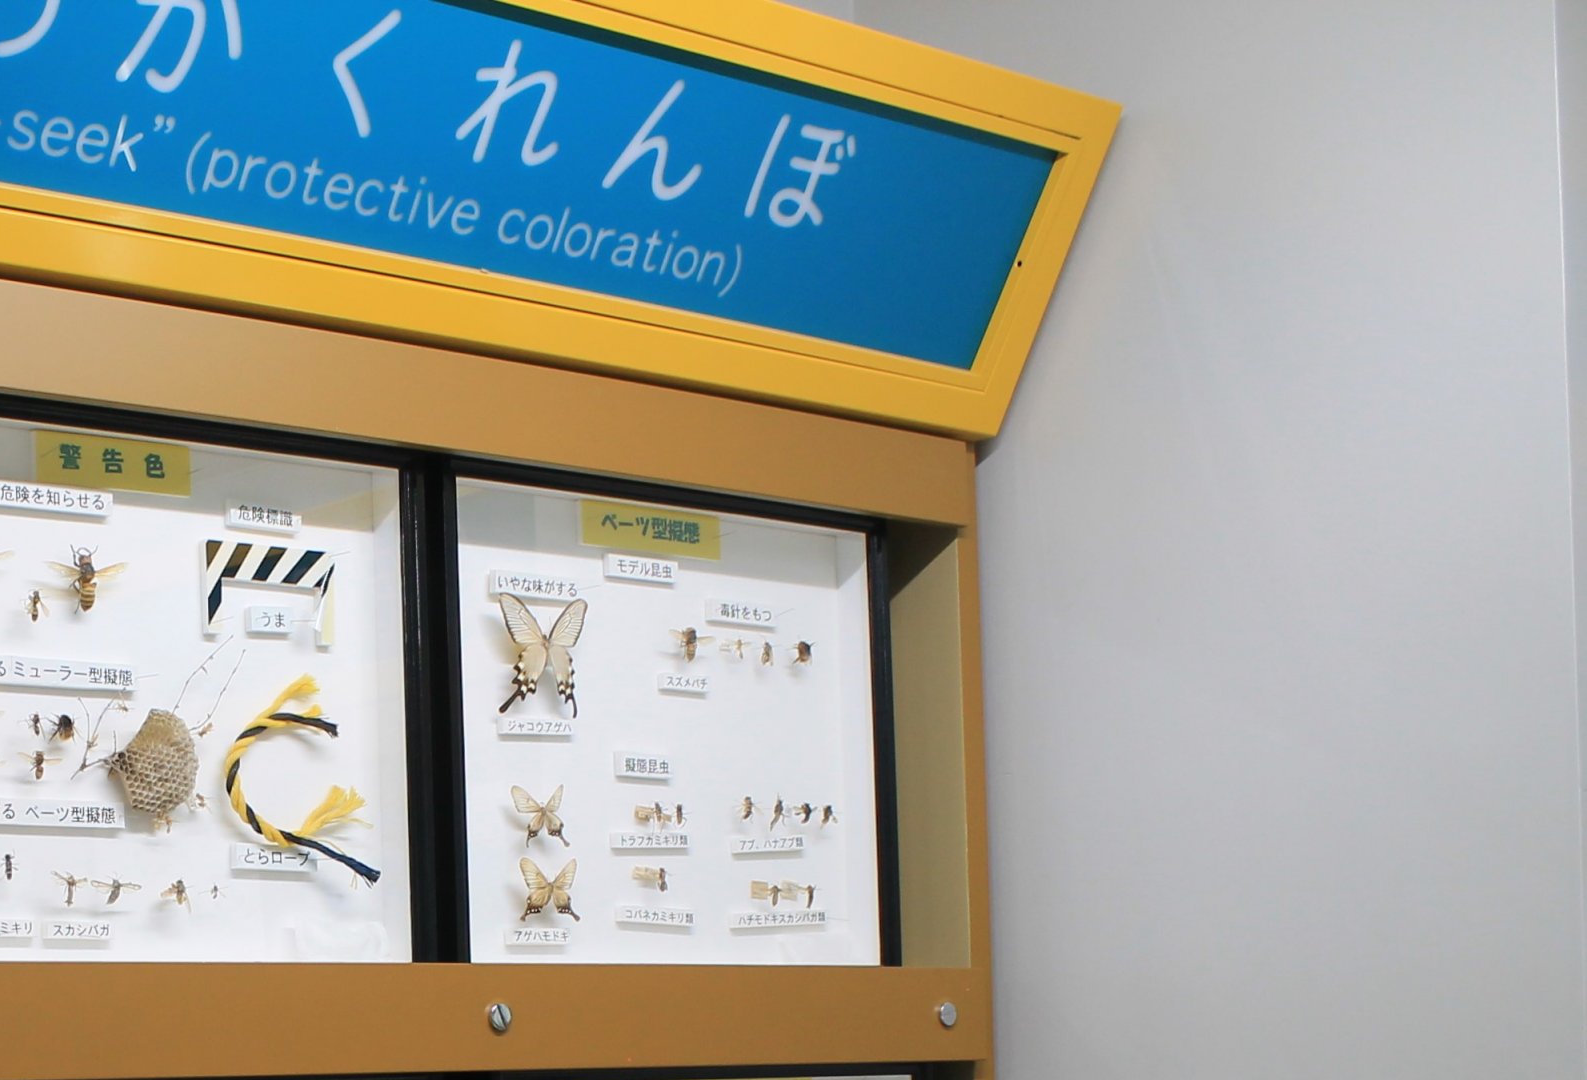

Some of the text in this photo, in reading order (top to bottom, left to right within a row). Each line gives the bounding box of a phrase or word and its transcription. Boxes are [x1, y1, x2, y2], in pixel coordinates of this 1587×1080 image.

[186, 131, 480, 236] (protective
[499, 207, 743, 297] coloration)
[238, 505, 294, 528] 危険標識
[617, 559, 672, 579] モデル昆虫
[497, 575, 577, 597] いやな味がする
[261, 612, 286, 629] うま
[14, 662, 133, 686] ミューラー型擬態
[625, 758, 670, 775] 擬態昆虫
